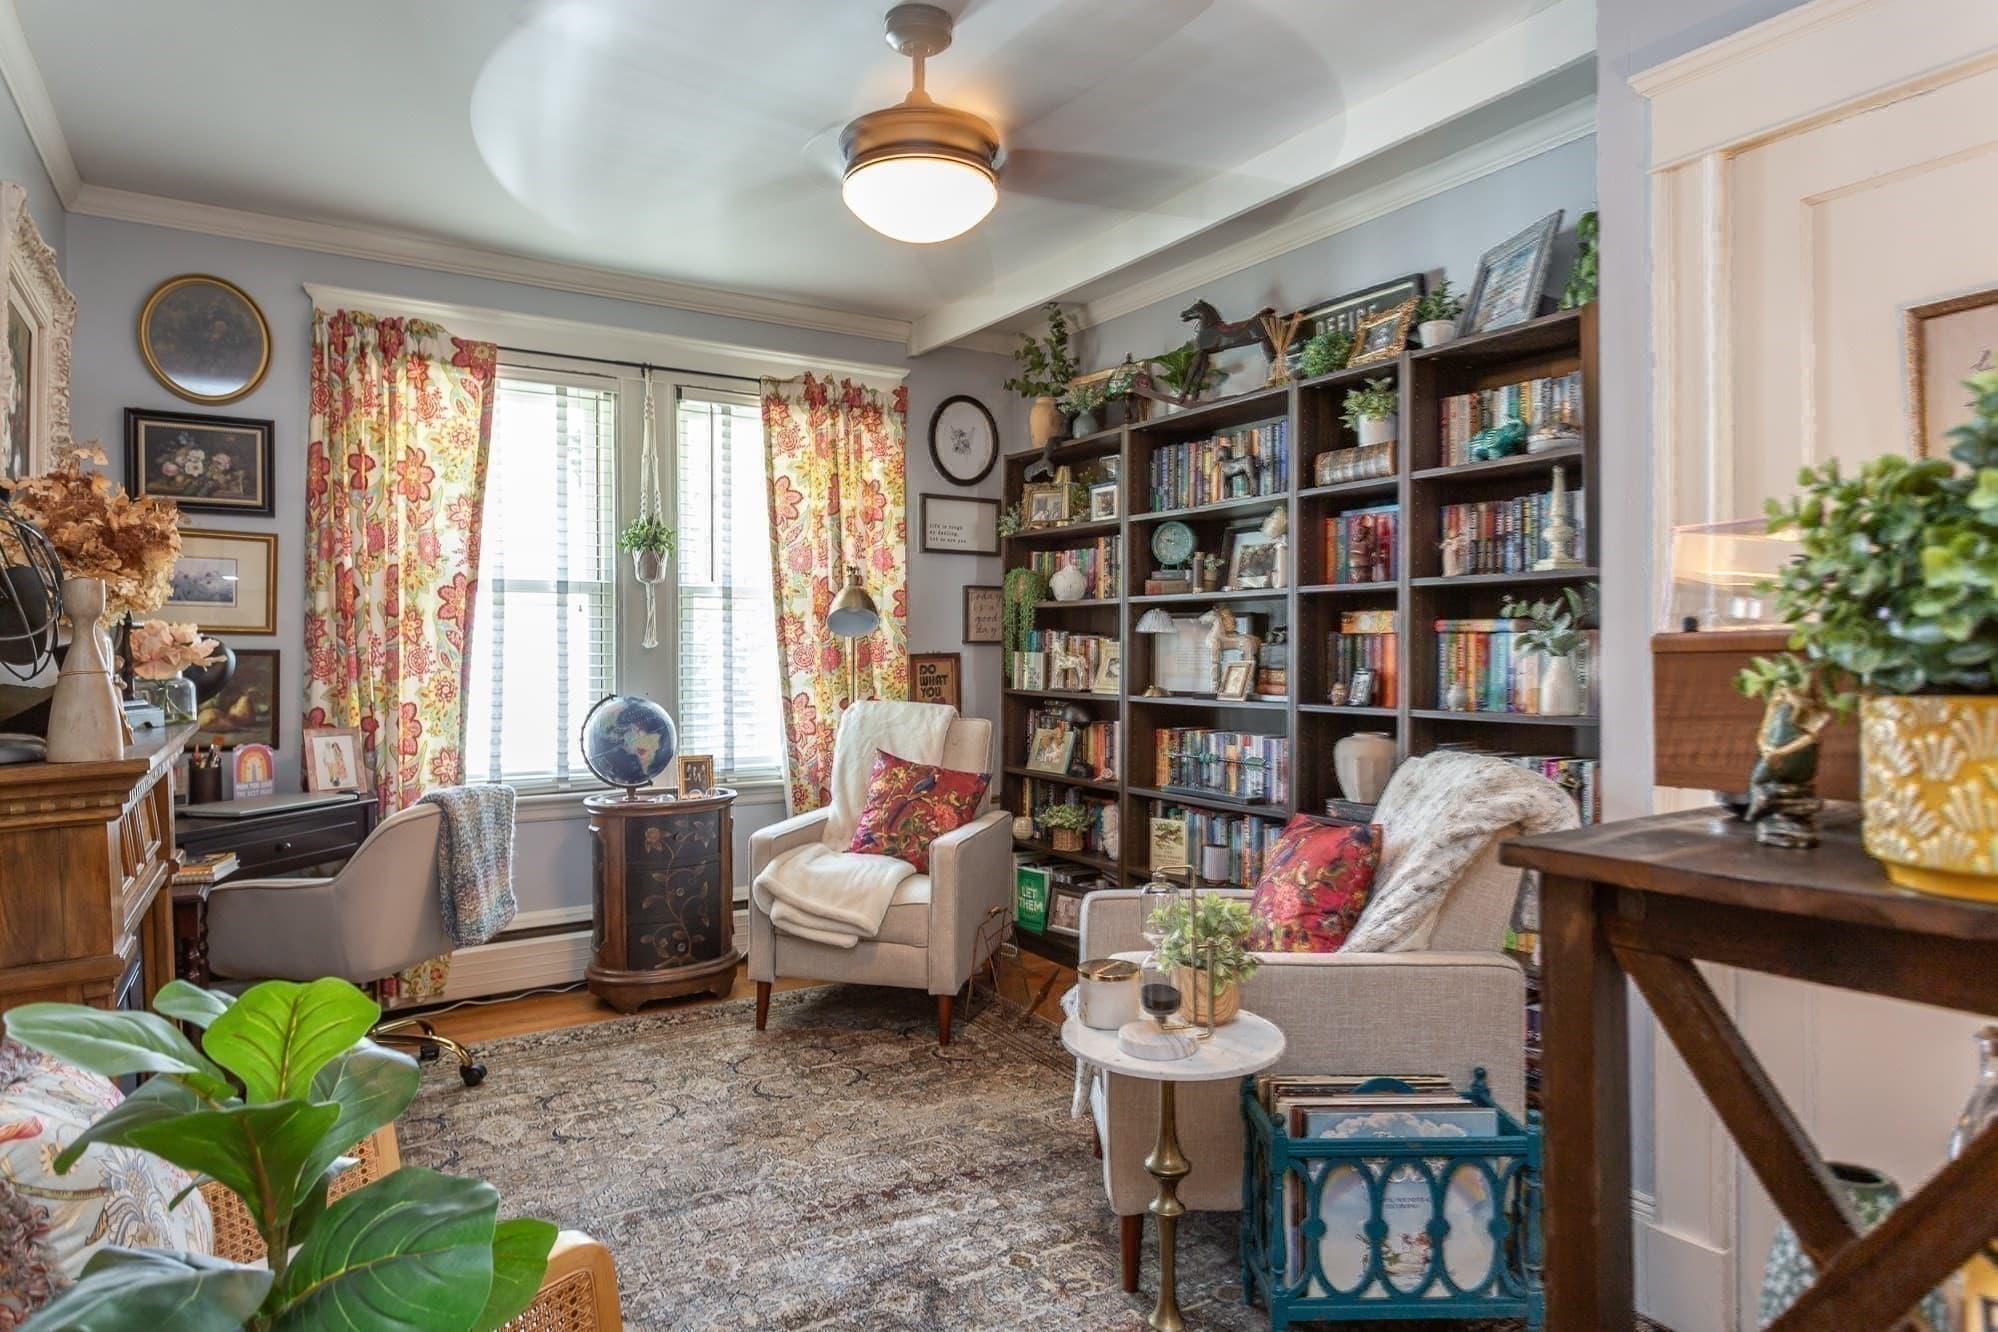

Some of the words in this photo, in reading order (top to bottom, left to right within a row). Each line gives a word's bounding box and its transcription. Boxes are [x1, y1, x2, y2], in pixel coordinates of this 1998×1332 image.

[919, 664, 936, 675] DO
[919, 674, 948, 687] WHAT
[920, 686, 941, 698] YOU
[1021, 885, 1038, 900] LET
[1018, 896, 1044, 912] THEM
